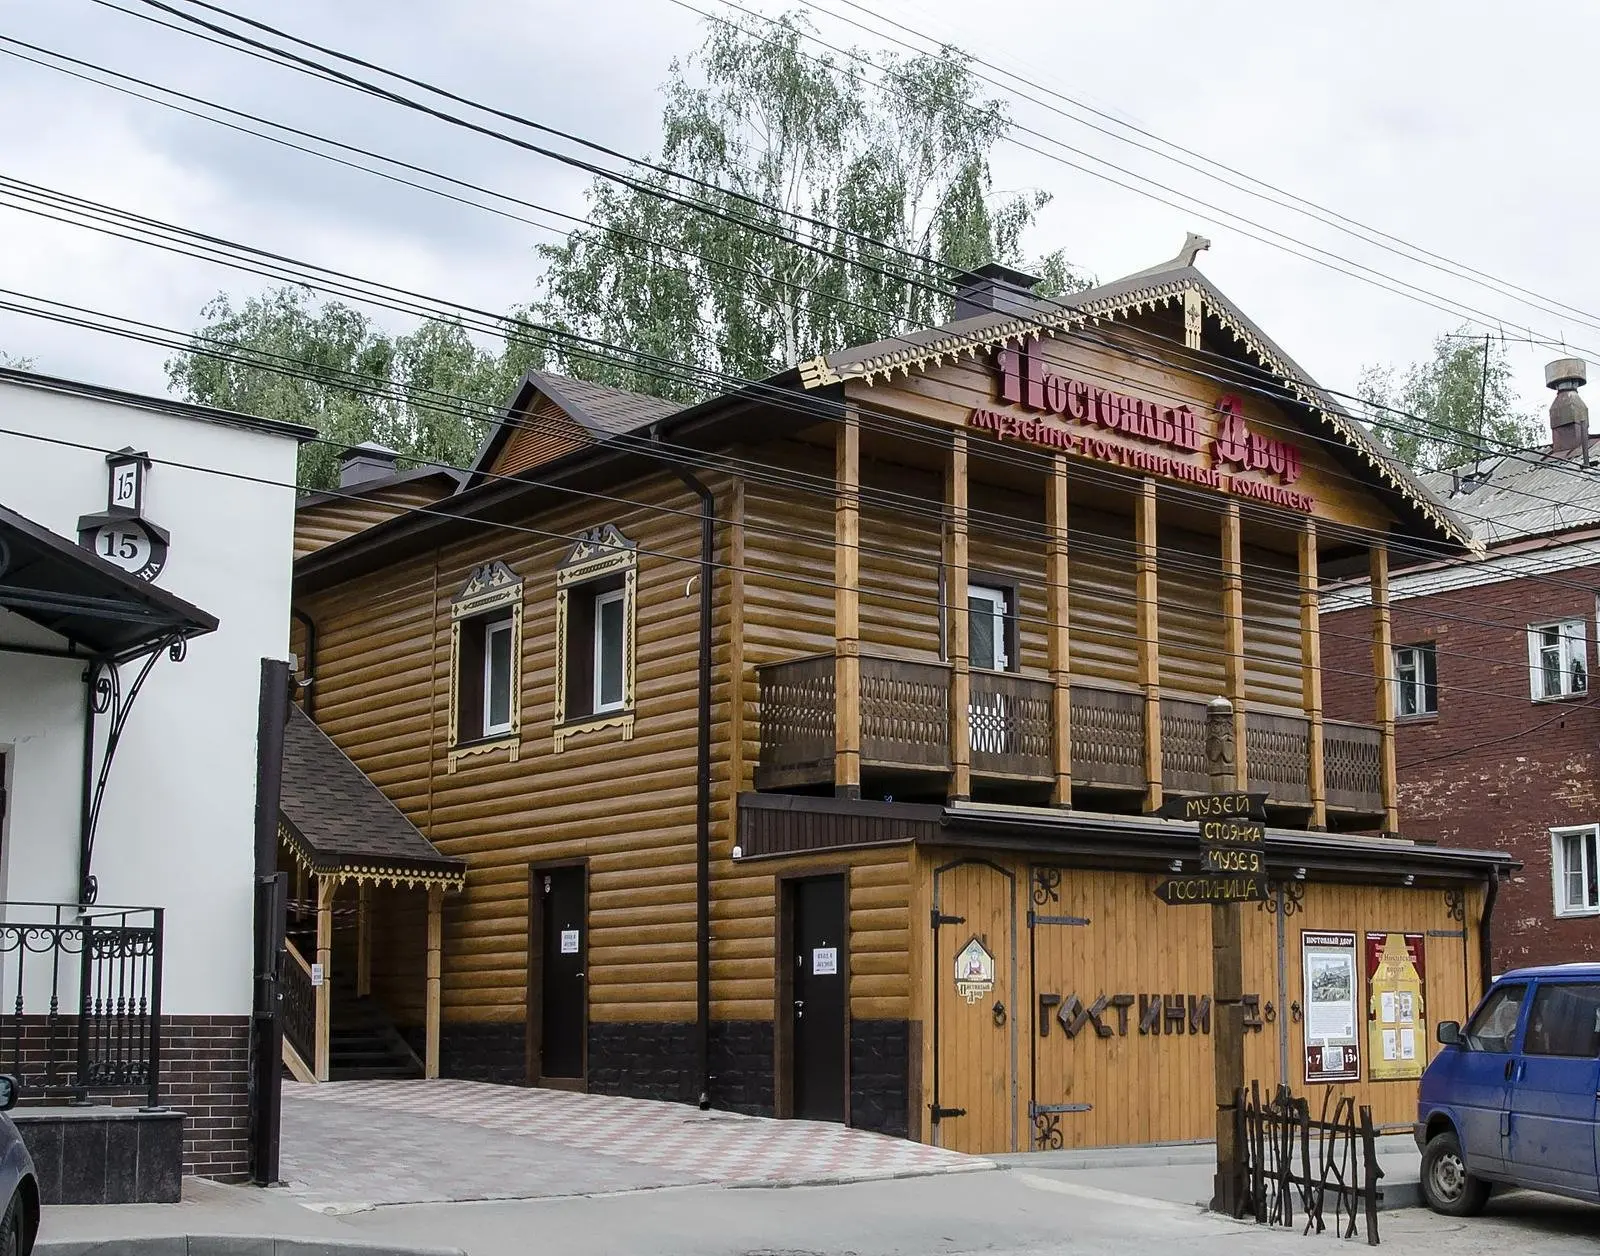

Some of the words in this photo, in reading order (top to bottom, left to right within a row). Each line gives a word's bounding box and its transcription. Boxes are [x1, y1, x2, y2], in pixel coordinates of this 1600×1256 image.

[117, 472, 134, 501] 15
[103, 532, 138, 559] 15
[1186, 795, 1250, 817] МУЗЕЙ
[1204, 822, 1261, 842] СТОЯНКА
[1208, 850, 1260, 872] МУЗЕЯ
[1168, 879, 1258, 900] ГОСТИНИЦА
